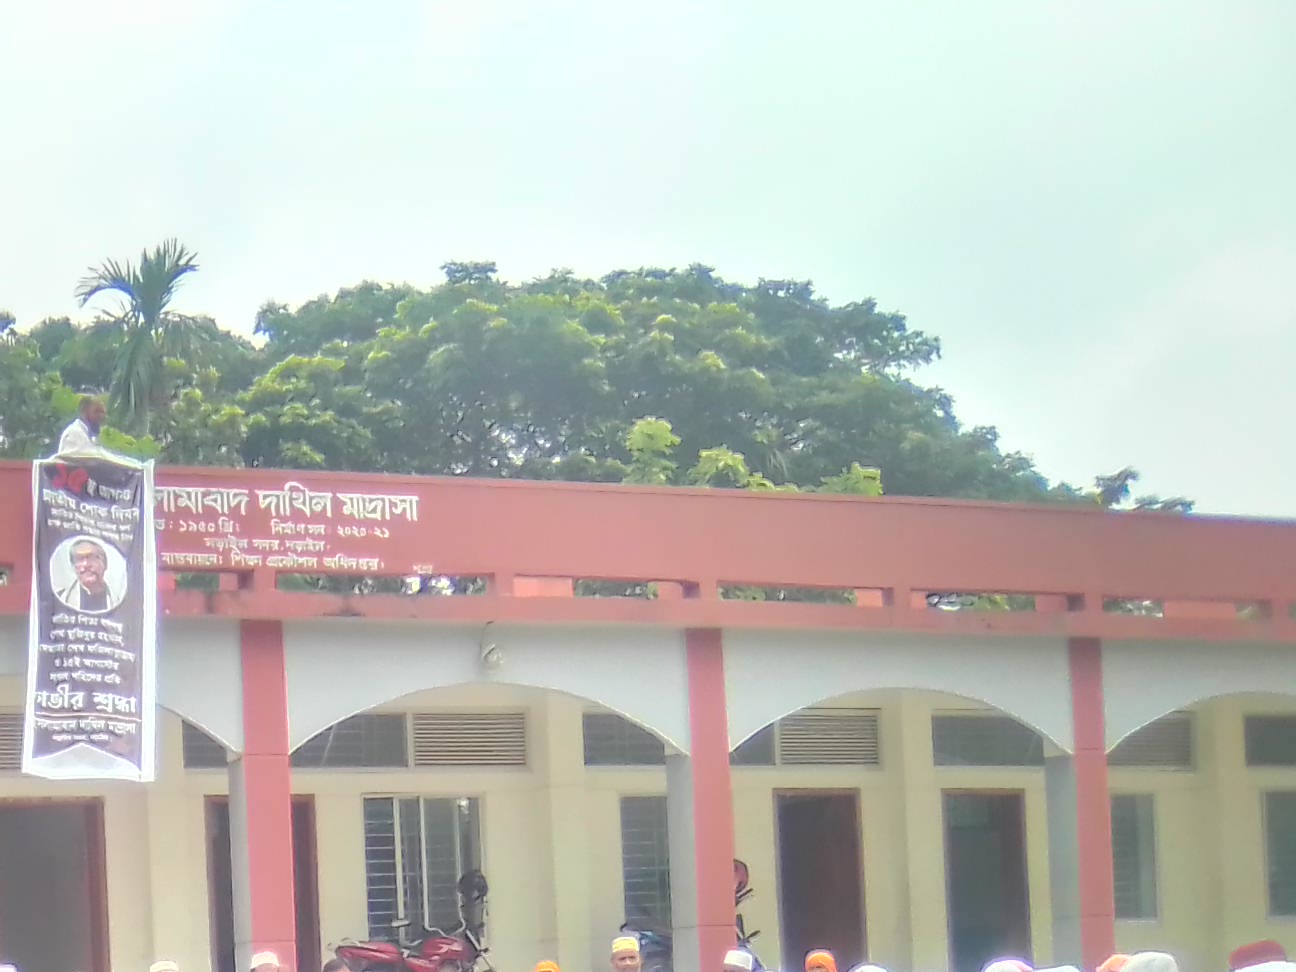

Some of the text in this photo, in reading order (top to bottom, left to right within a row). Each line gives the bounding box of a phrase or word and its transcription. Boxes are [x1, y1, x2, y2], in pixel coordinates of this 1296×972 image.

[79, 501, 109, 518] শোক
[154, 481, 419, 522] লামাবাদ দাখিল মাদ্রাসা
[34, 683, 137, 713] গভীর শ্রদ্ধা
